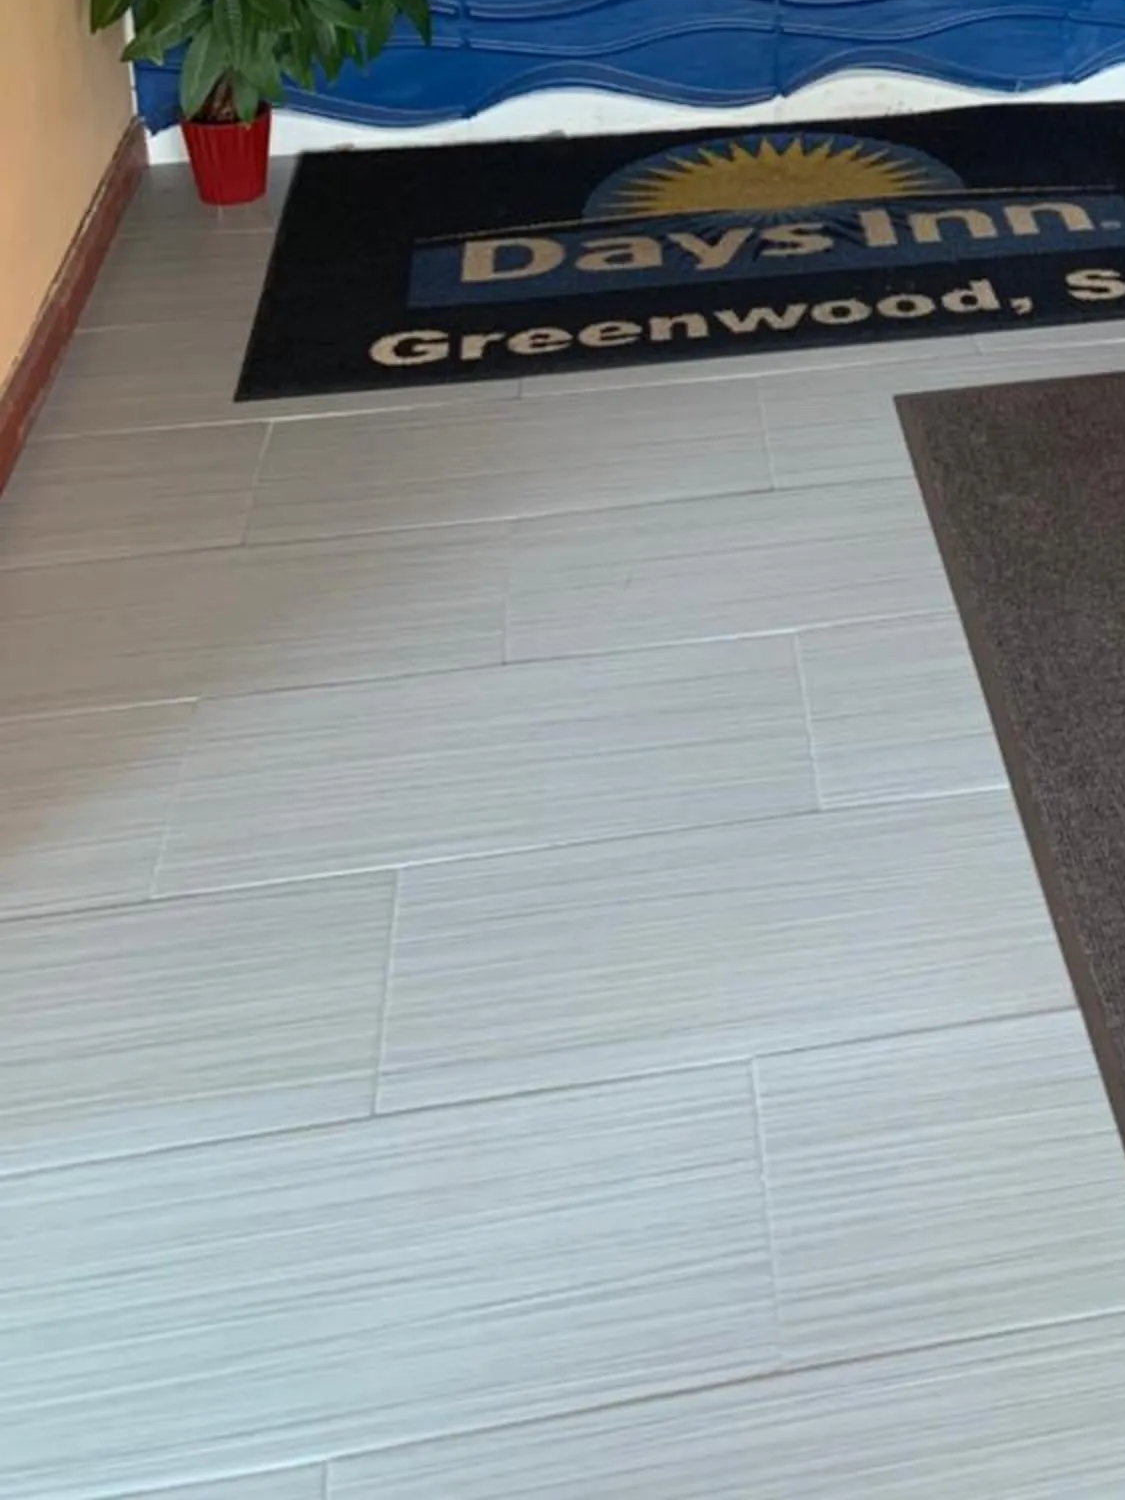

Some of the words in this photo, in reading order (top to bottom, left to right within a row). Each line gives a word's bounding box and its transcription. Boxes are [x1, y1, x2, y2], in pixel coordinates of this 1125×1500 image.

[461, 222, 834, 283] Days
[858, 202, 1095, 248] Inn
[368, 278, 1034, 366] Greenwood,
